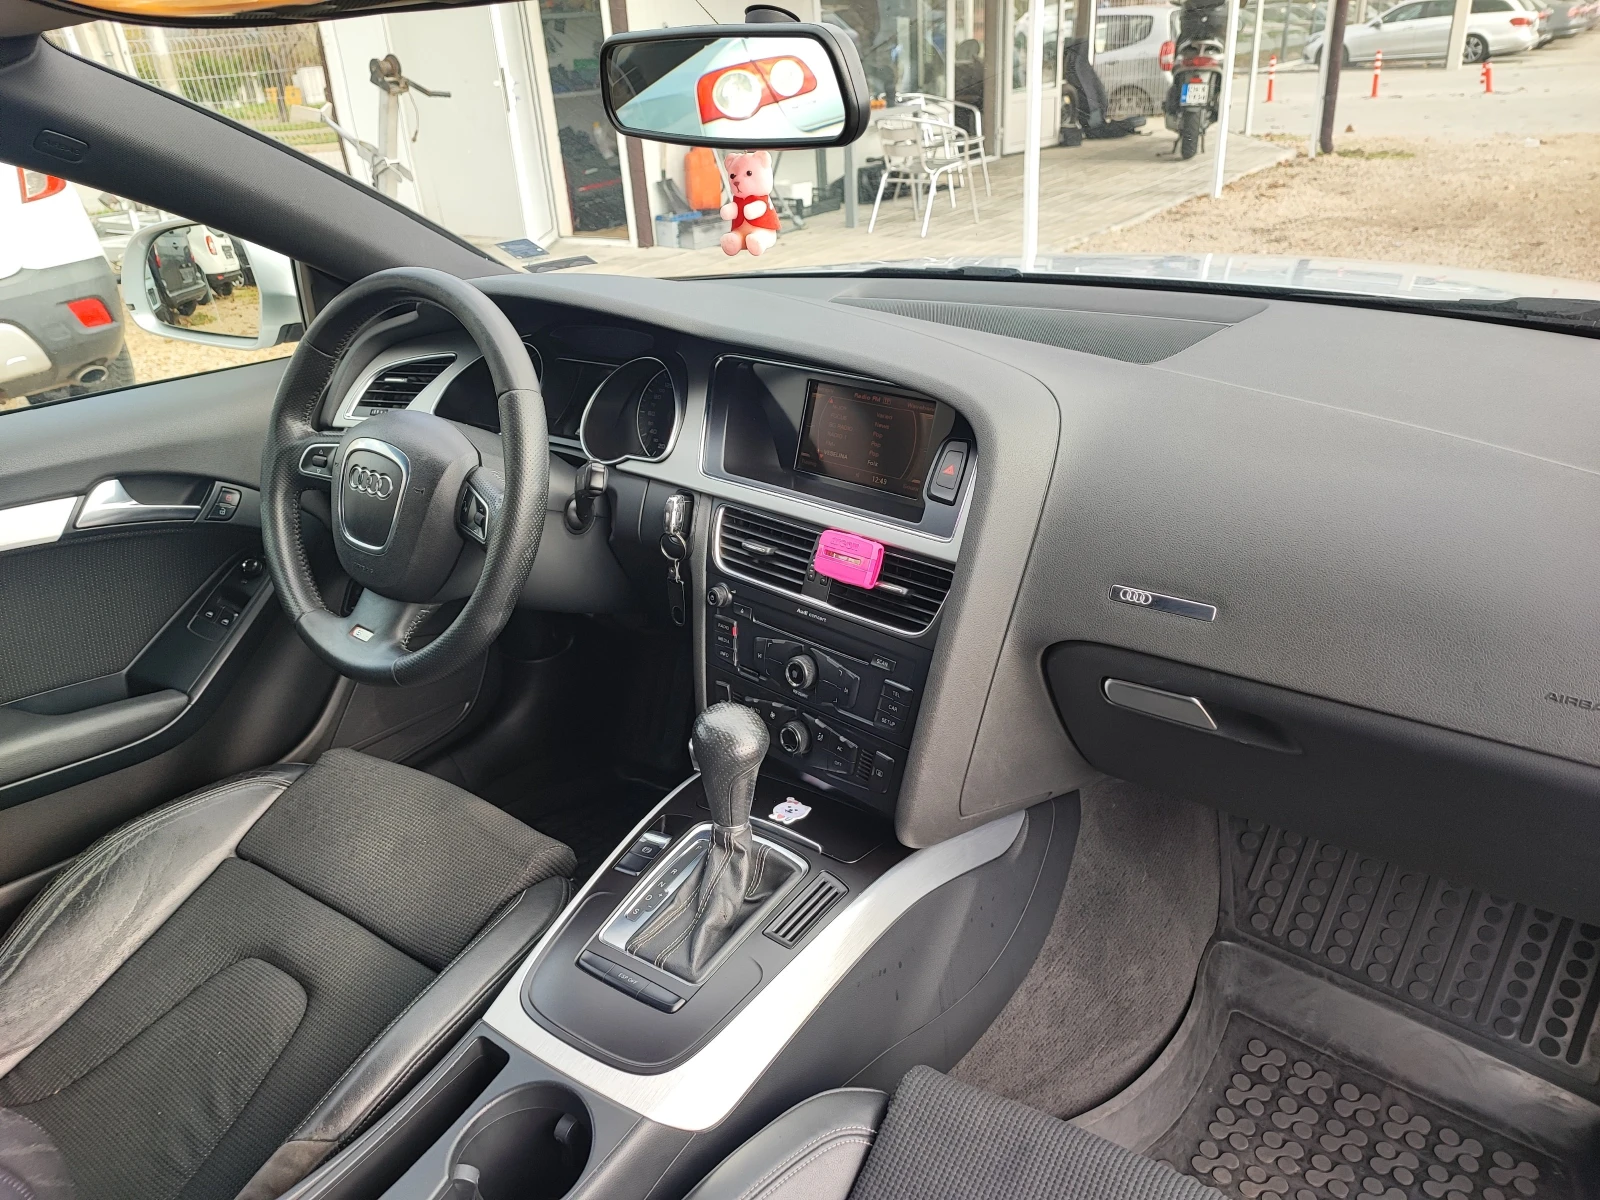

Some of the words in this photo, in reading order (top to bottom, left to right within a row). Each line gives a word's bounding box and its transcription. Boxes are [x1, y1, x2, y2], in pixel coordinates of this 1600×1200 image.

[854, 392, 870, 401] Radio
[866, 460, 879, 468] Folk
[796, 607, 809, 616] Audi
[875, 658, 889, 667] SCAN
[891, 690, 901, 699] TEL
[1543, 692, 1600, 711] AIRB
[887, 704, 899, 713] CAR
[880, 716, 897, 728] SETUP
